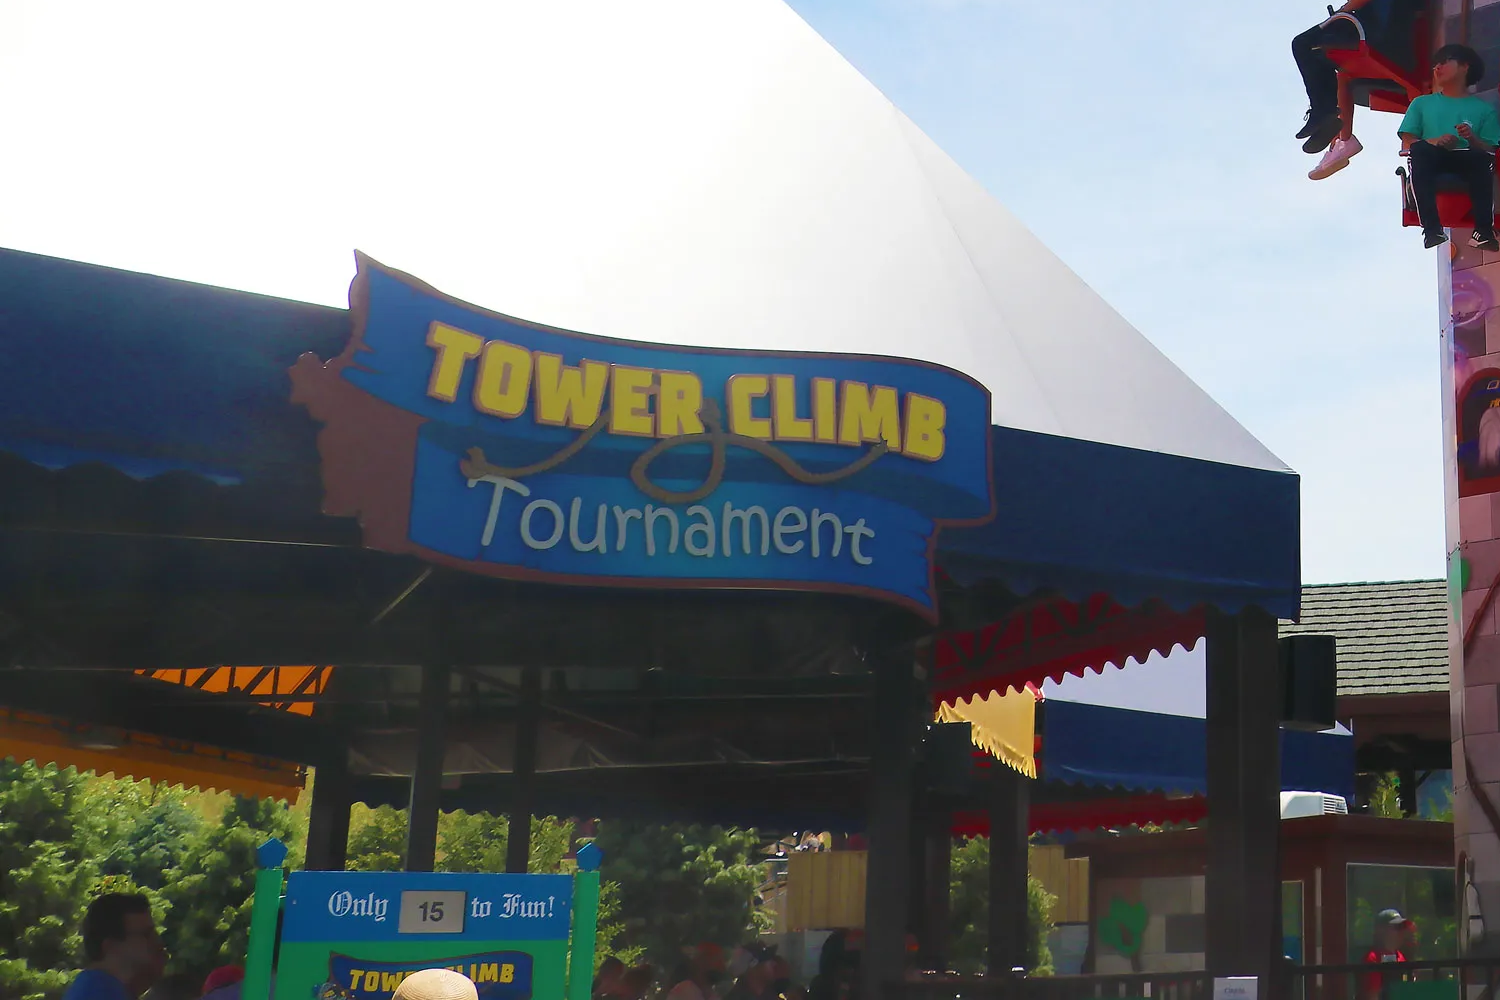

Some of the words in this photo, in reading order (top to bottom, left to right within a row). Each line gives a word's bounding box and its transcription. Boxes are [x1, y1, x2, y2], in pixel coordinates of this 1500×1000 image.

[427, 322, 704, 438] TOWER
[726, 373, 947, 462] CLIMB
[468, 474, 875, 565] Tournament
[328, 890, 389, 922] Only
[419, 901, 445, 922] 15
[471, 896, 493, 919] to
[499, 893, 556, 919] Fun!
[350, 969, 416, 993] TOW
[446, 963, 515, 984] IMB
